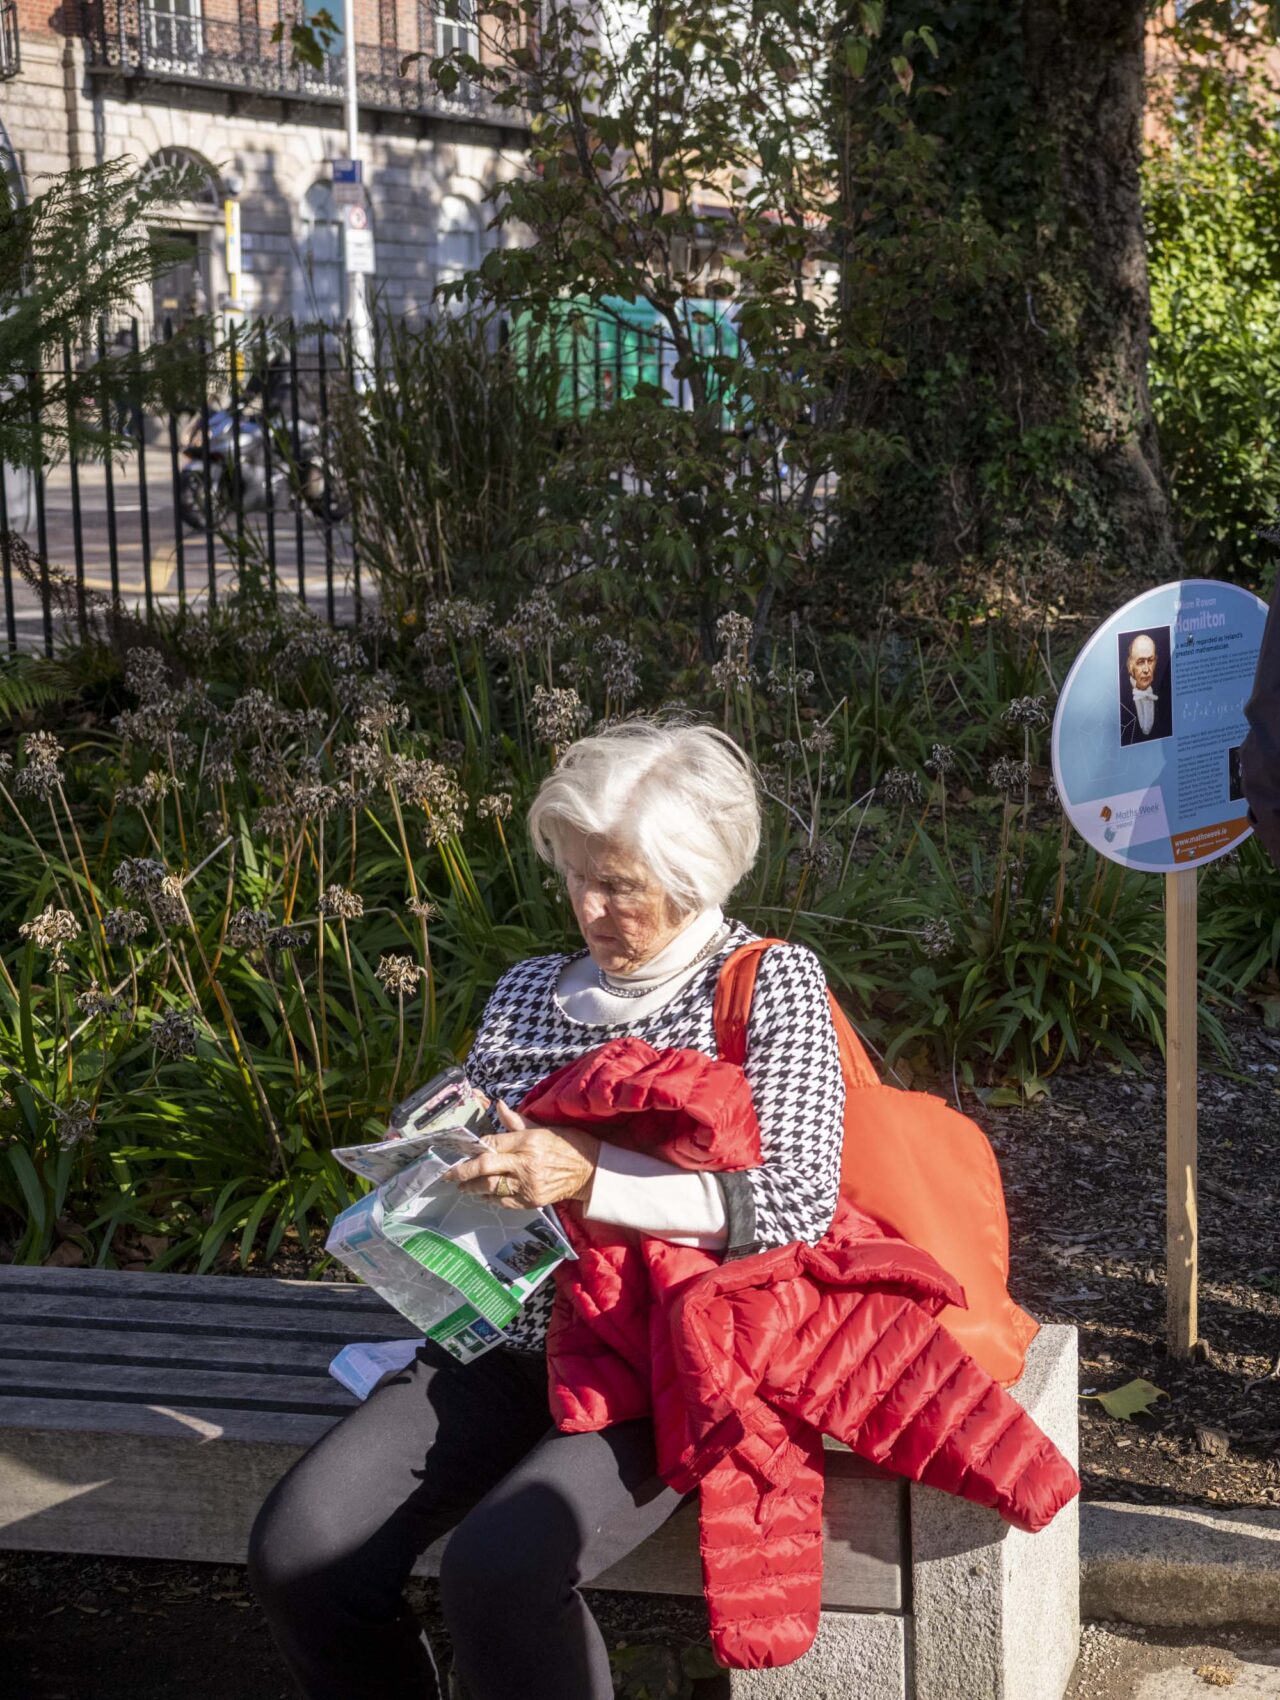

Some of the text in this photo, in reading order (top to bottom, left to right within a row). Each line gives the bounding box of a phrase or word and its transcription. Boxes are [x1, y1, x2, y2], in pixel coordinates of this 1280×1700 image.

[1195, 597, 1217, 608] Rowan
[1175, 610, 1226, 633] Hamilton
[1195, 636, 1217, 646] regarded
[1175, 828, 1228, 847] www.mathsweek.ie
